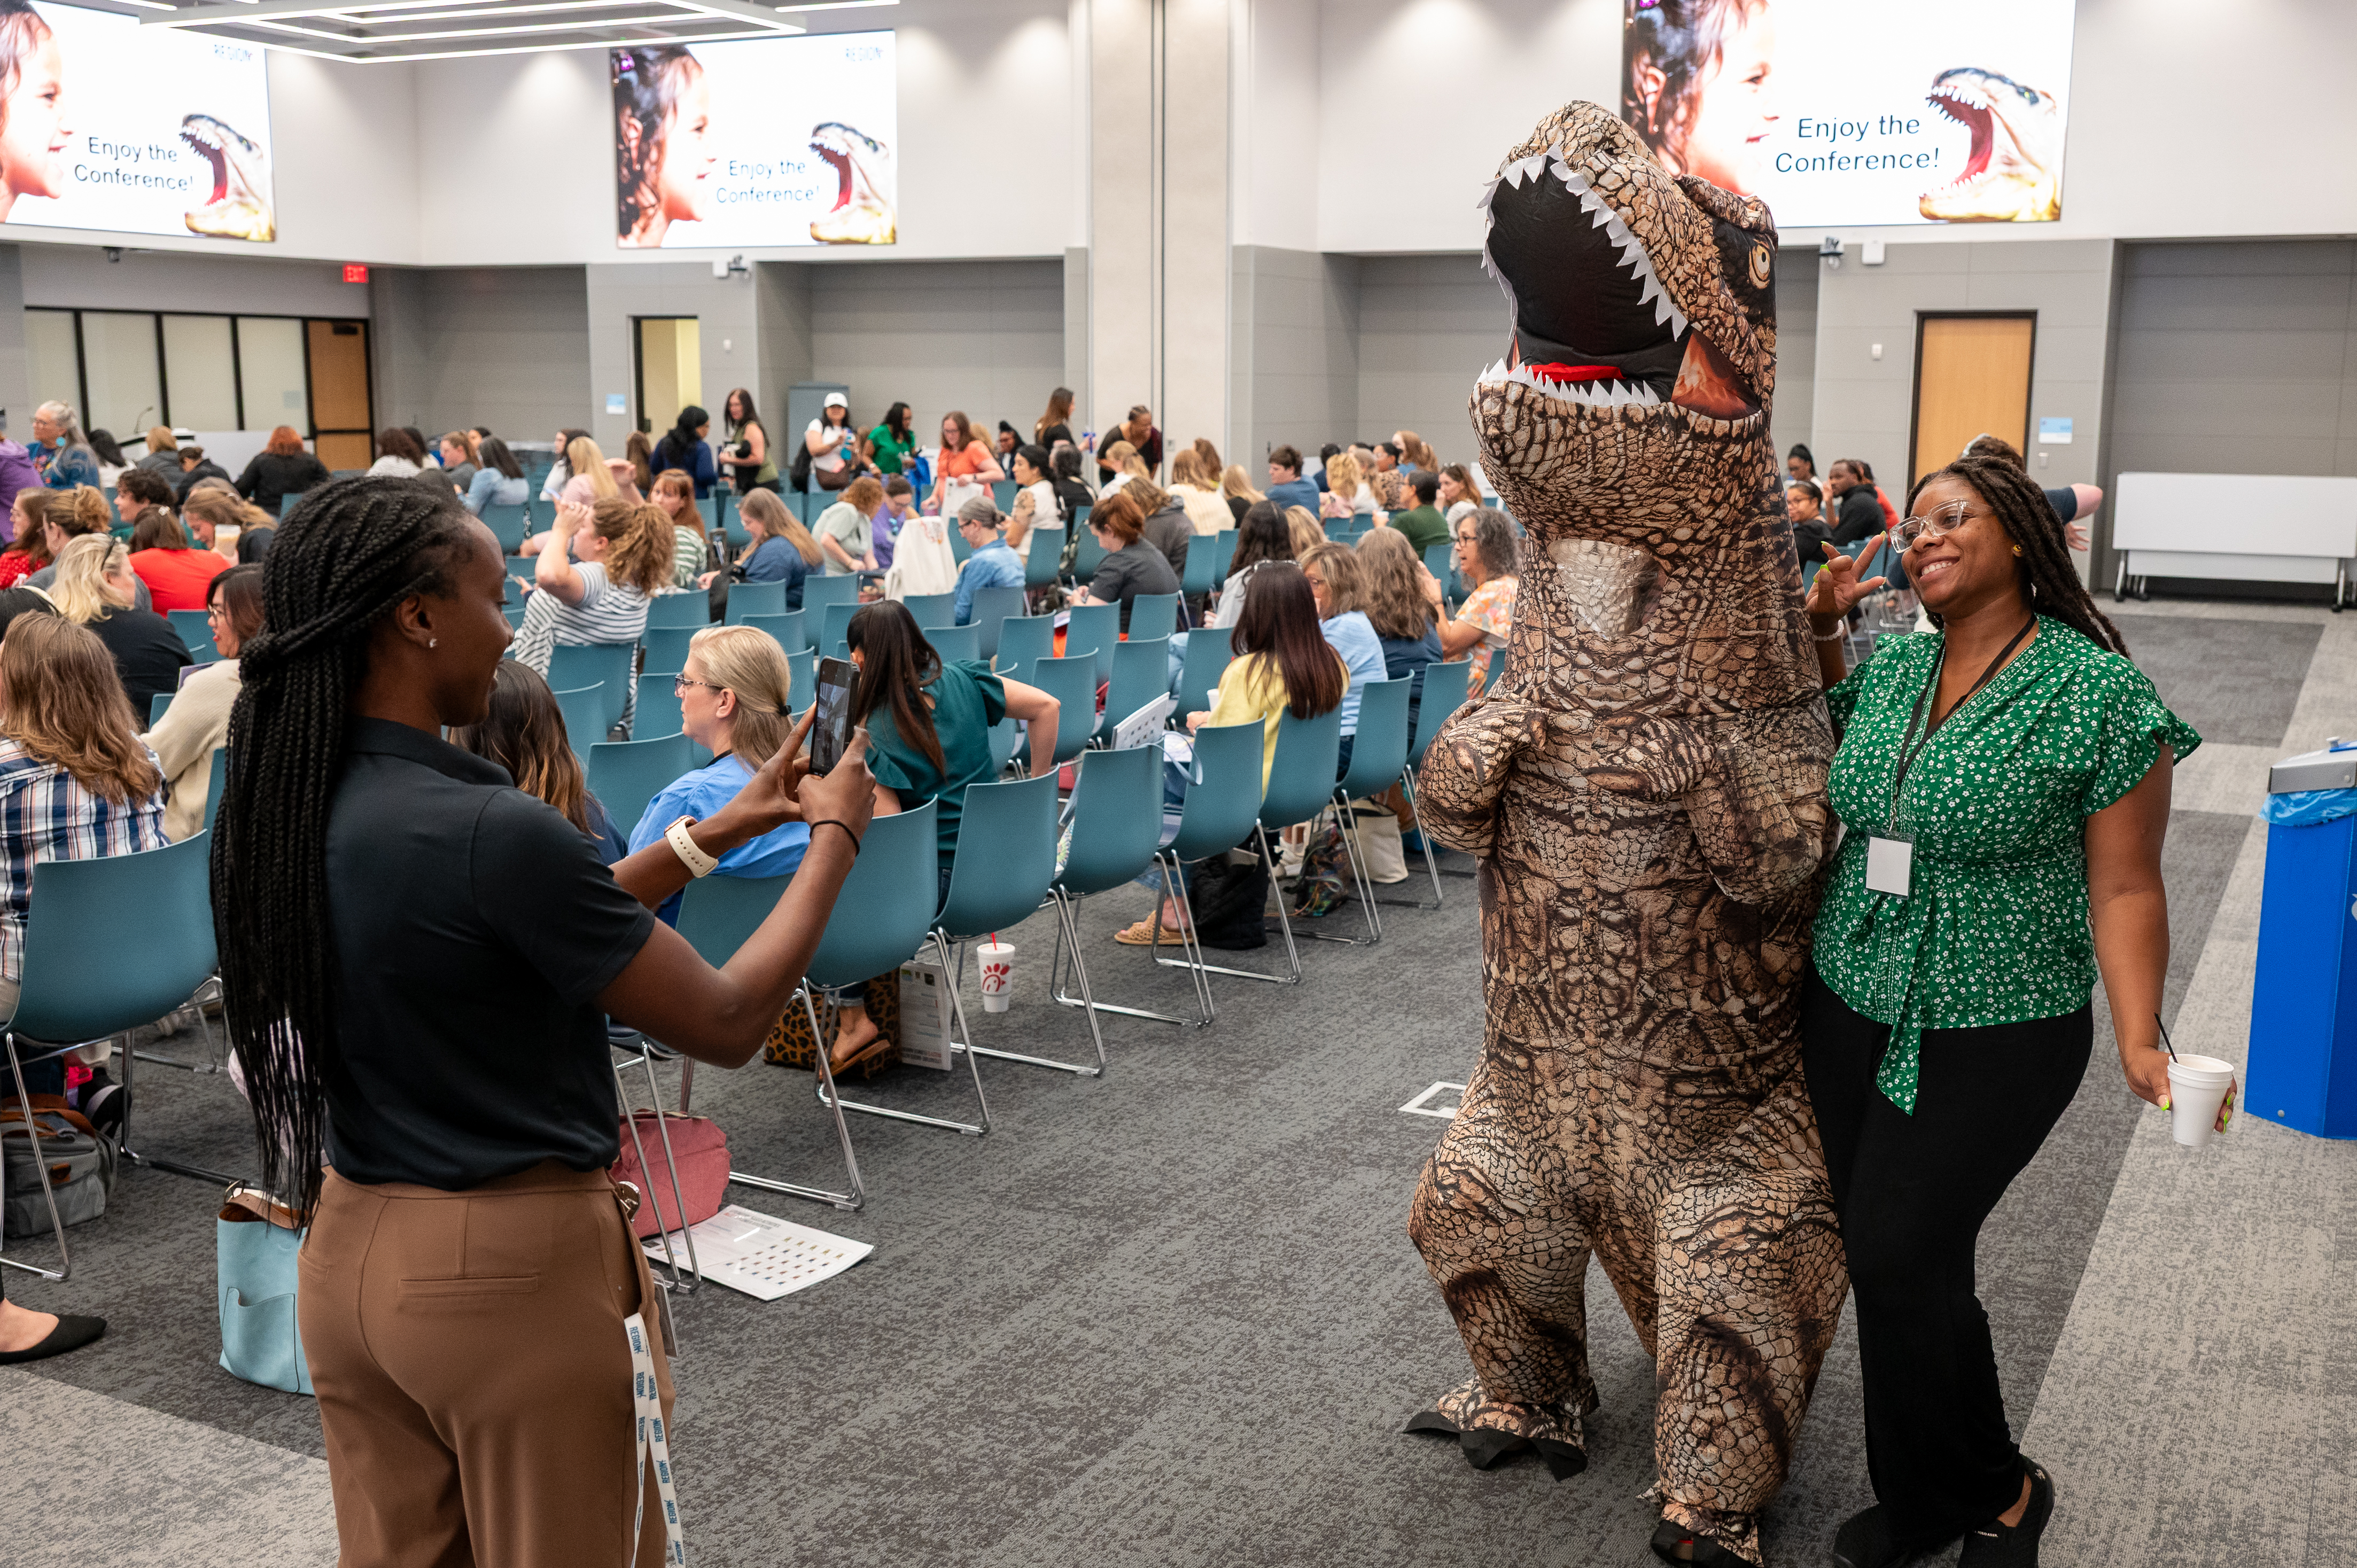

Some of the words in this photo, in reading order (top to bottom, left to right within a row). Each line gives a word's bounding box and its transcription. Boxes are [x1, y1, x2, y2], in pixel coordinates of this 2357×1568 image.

[1798, 117, 1869, 143] Enjoy
[1879, 115, 1920, 135] the
[89, 137, 141, 162] Enjoy
[149, 144, 177, 162] the
[1776, 147, 1939, 173] Conference!
[74, 164, 193, 191] Conference!
[729, 160, 773, 180] Enjoy
[780, 159, 805, 174] the
[717, 185, 819, 203] Conference!
